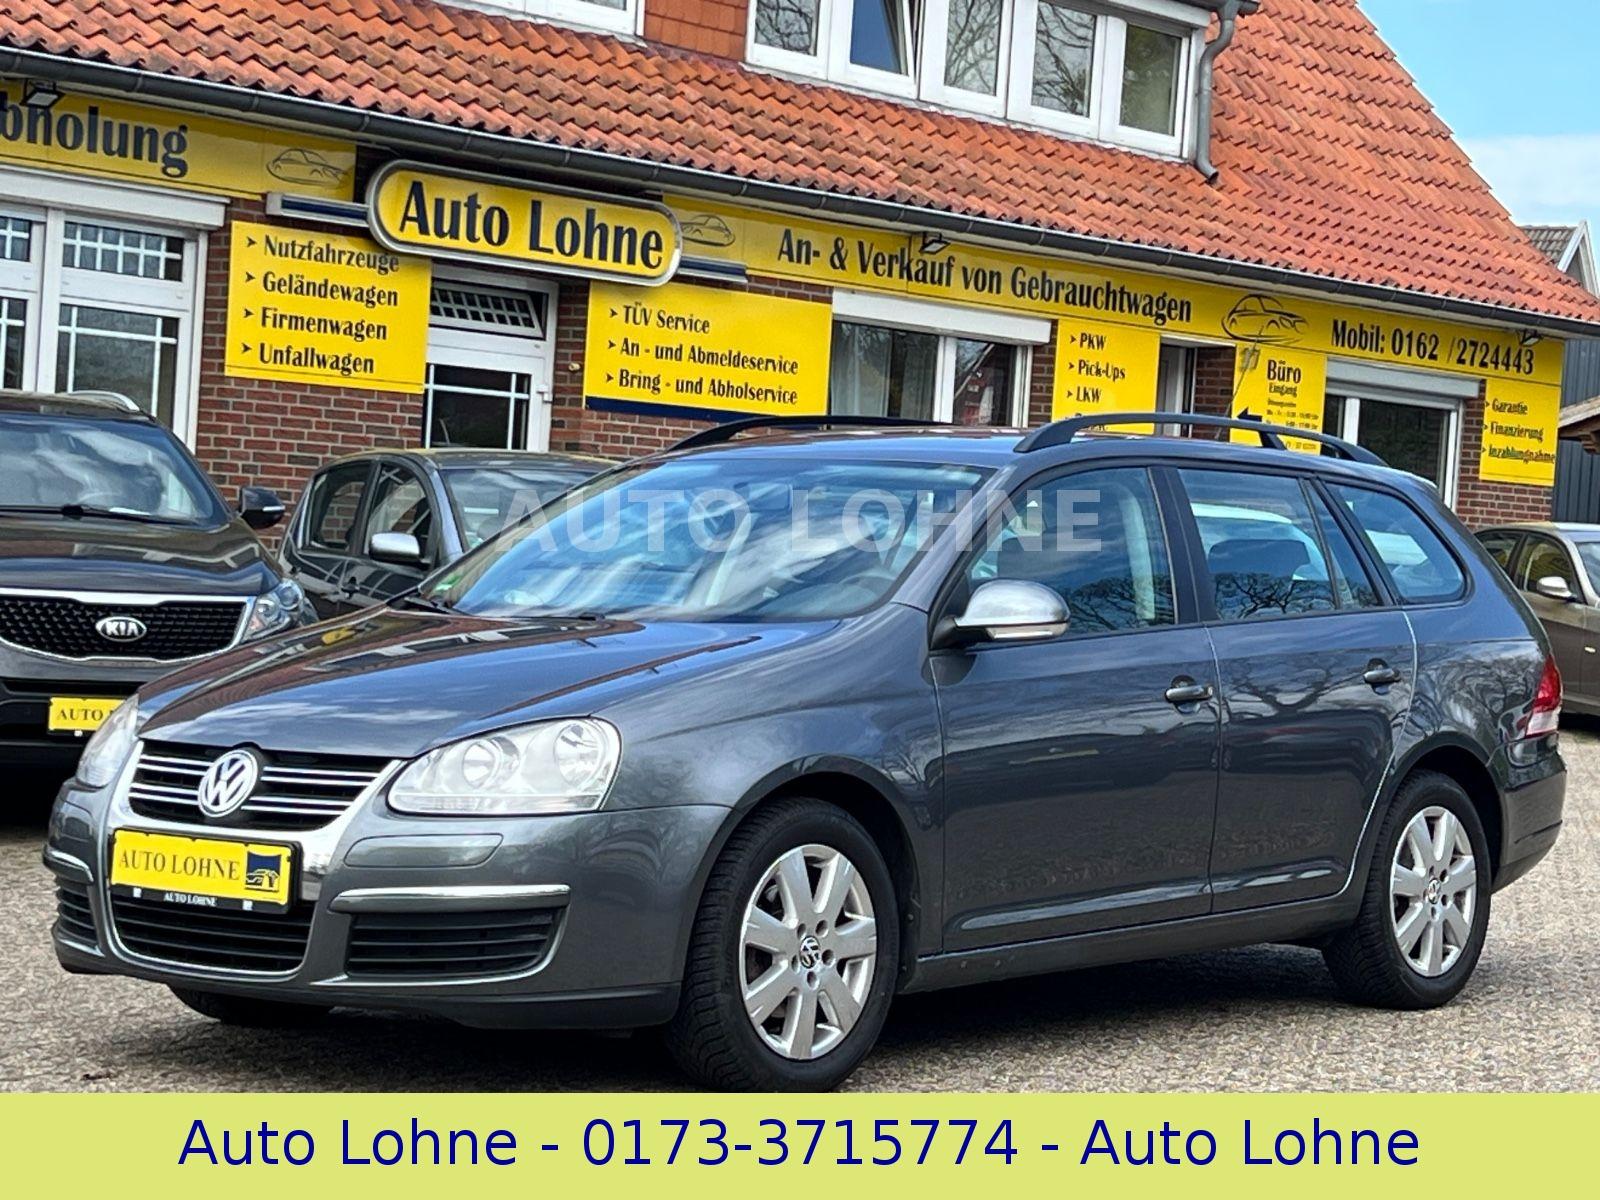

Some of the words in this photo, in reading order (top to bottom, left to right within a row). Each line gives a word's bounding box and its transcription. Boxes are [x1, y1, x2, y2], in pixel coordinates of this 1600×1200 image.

[400, 181, 510, 247] Auto
[529, 200, 664, 270] Lohne
[264, 235, 400, 275] Nutzfahrzeuge
[263, 271, 399, 310] Geländewagen
[778, 228, 820, 266] An-
[829, 237, 848, 271] &
[858, 242, 955, 288] Verkauf
[962, 264, 1001, 296] von
[1011, 266, 1192, 326] Gebrauchtwagen
[261, 307, 388, 342] Firmenwagen
[622, 302, 653, 327] TÜV
[657, 310, 710, 335] Service
[1080, 332, 1107, 351] PKW
[1332, 320, 1386, 352] Mobil:
[1391, 328, 1440, 361] 0162
[259, 343, 375, 377] Unfallwagen
[620, 339, 641, 358] An
[655, 343, 683, 363] und
[688, 346, 799, 376] Abmeldeservice
[1078, 359, 1126, 382] Pick-Ups
[1267, 359, 1302, 384] Büro
[619, 370, 661, 394] Bring
[675, 376, 703, 396] und
[708, 379, 798, 405] Abholservice
[1076, 386, 1102, 404] LKW
[1491, 398, 1528, 415] Garantie
[1490, 421, 1544, 443] Finanzierung
[105, 620, 139, 637] KIA
[57, 708, 104, 722] AUTO
[119, 850, 166, 873] AUTO
[172, 855, 241, 881] LOHNE
[164, 892, 186, 905] AUTO
[187, 895, 218, 908] LOHNE
